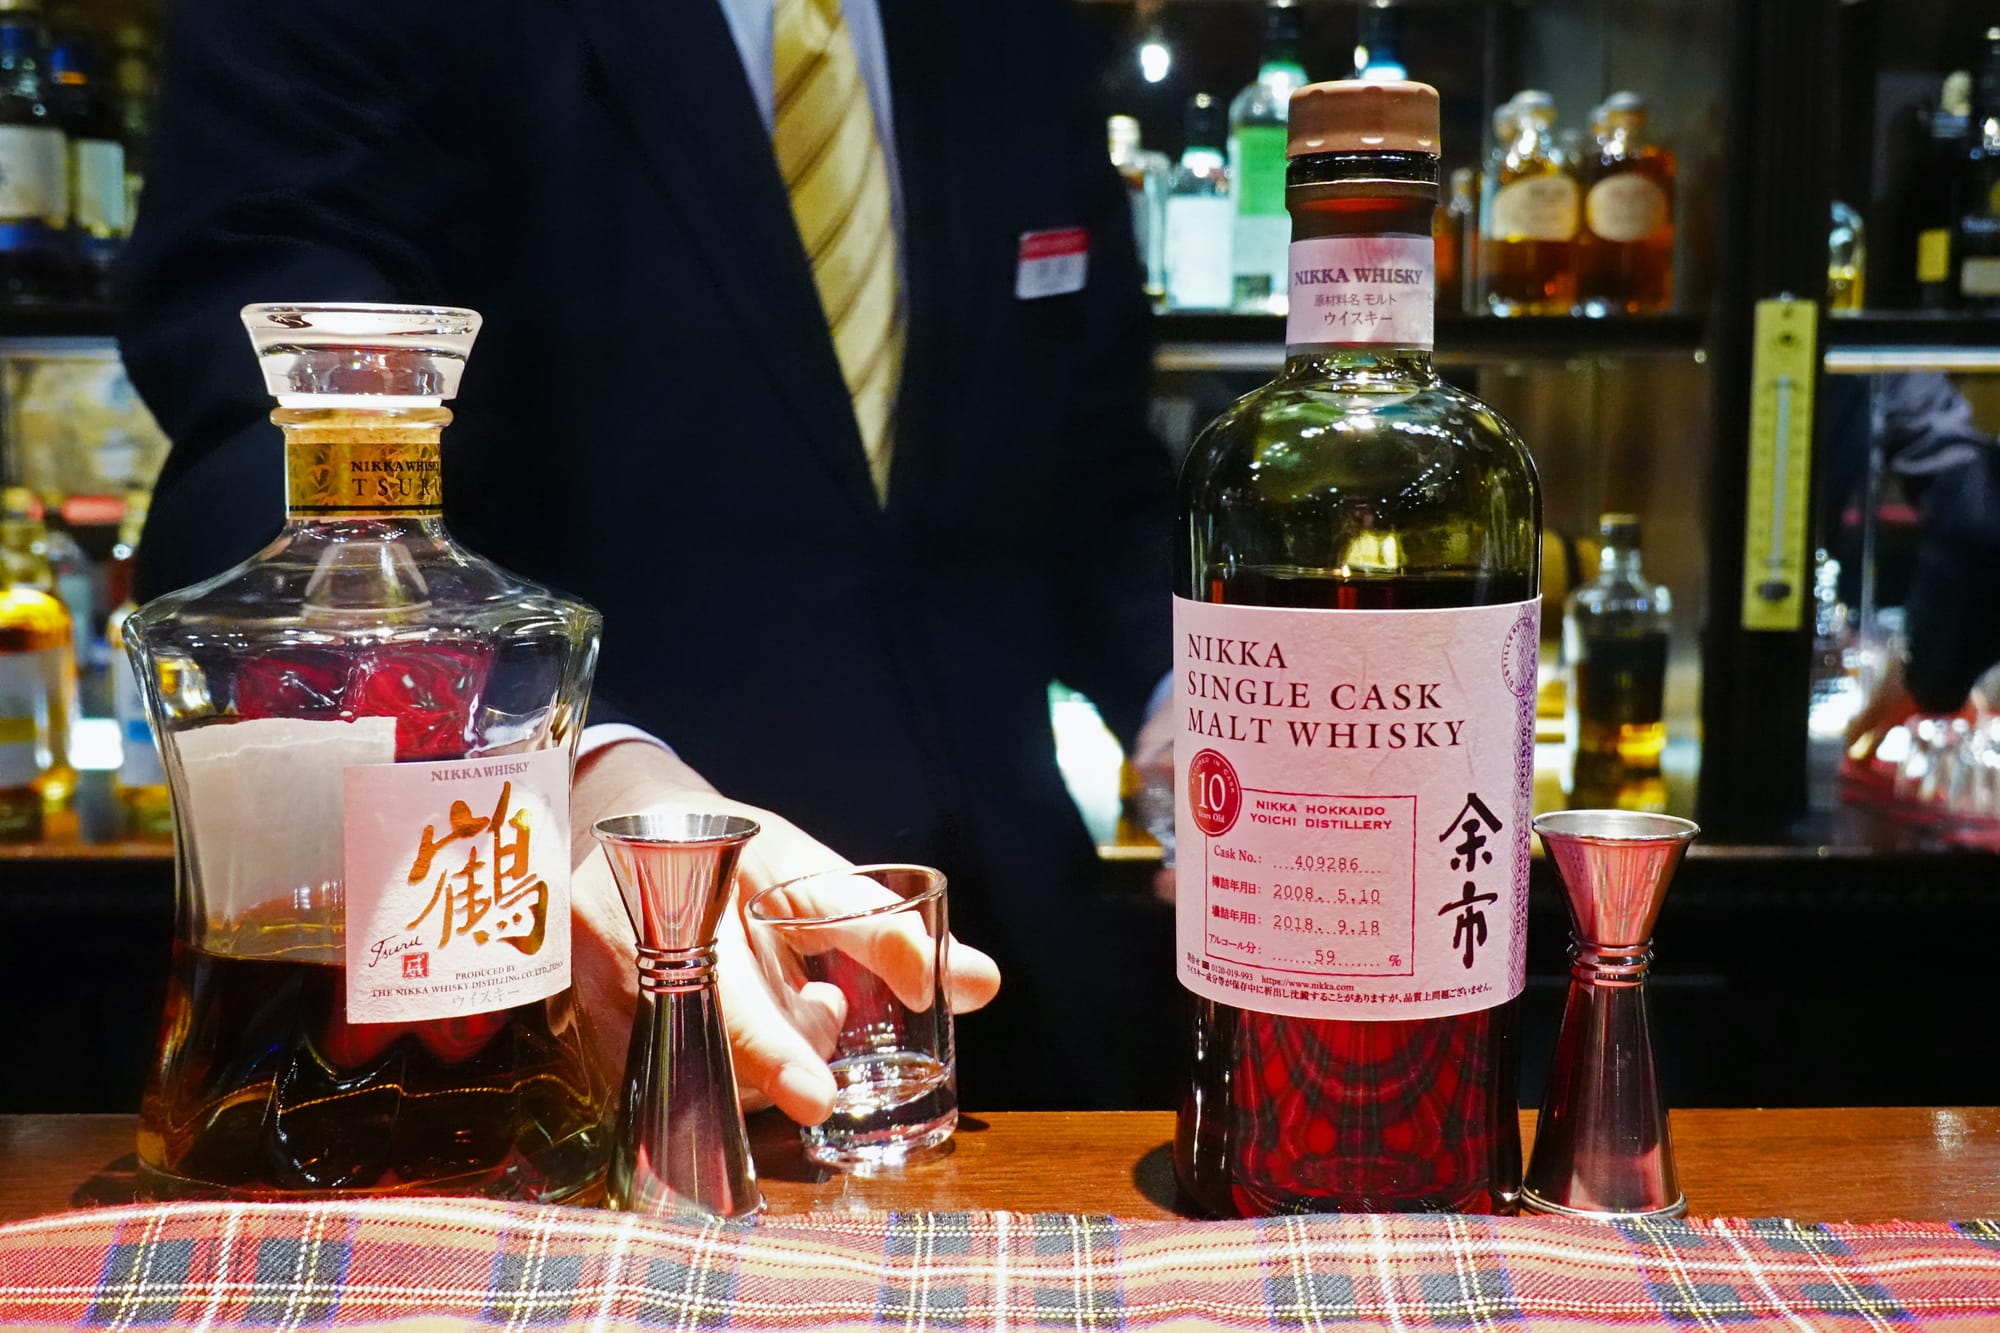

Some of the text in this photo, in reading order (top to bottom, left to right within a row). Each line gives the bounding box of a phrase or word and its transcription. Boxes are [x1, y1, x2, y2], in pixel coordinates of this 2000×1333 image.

[1295, 268, 1423, 286] NIKKA WHISKY
[1314, 294, 1397, 307] 原材料名 モルト
[1324, 311, 1393, 327] ウイスキー
[351, 461, 404, 472] NIKKA
[1188, 632, 1288, 669] NIKKA
[1188, 670, 1443, 711] SINGLE CASK
[1188, 707, 1465, 749] MALT WHISKY
[432, 761, 530, 780] NIKKA WHISKY
[1198, 771, 1226, 812] 10
[1256, 800, 1386, 816] NIKKA HOKKAIDO
[1250, 813, 1393, 831] YOICHI DISTILLERY
[1213, 844, 1236, 860] Cask
[1294, 855, 1359, 871] 409286
[406, 781, 548, 955] 鶴
[1438, 792, 1503, 969] 余市
[368, 934, 424, 968] Tsuru
[1315, 949, 1336, 964] 59
[1388, 954, 1402, 967] %
[455, 964, 516, 981] PRODUCED BY
[371, 988, 393, 998] THE
[396, 986, 430, 997] NIKKA
[431, 981, 469, 993] WHISKY
[1261, 974, 1355, 992] https://www.nikka.com
[452, 988, 521, 1010] ウイスキー
